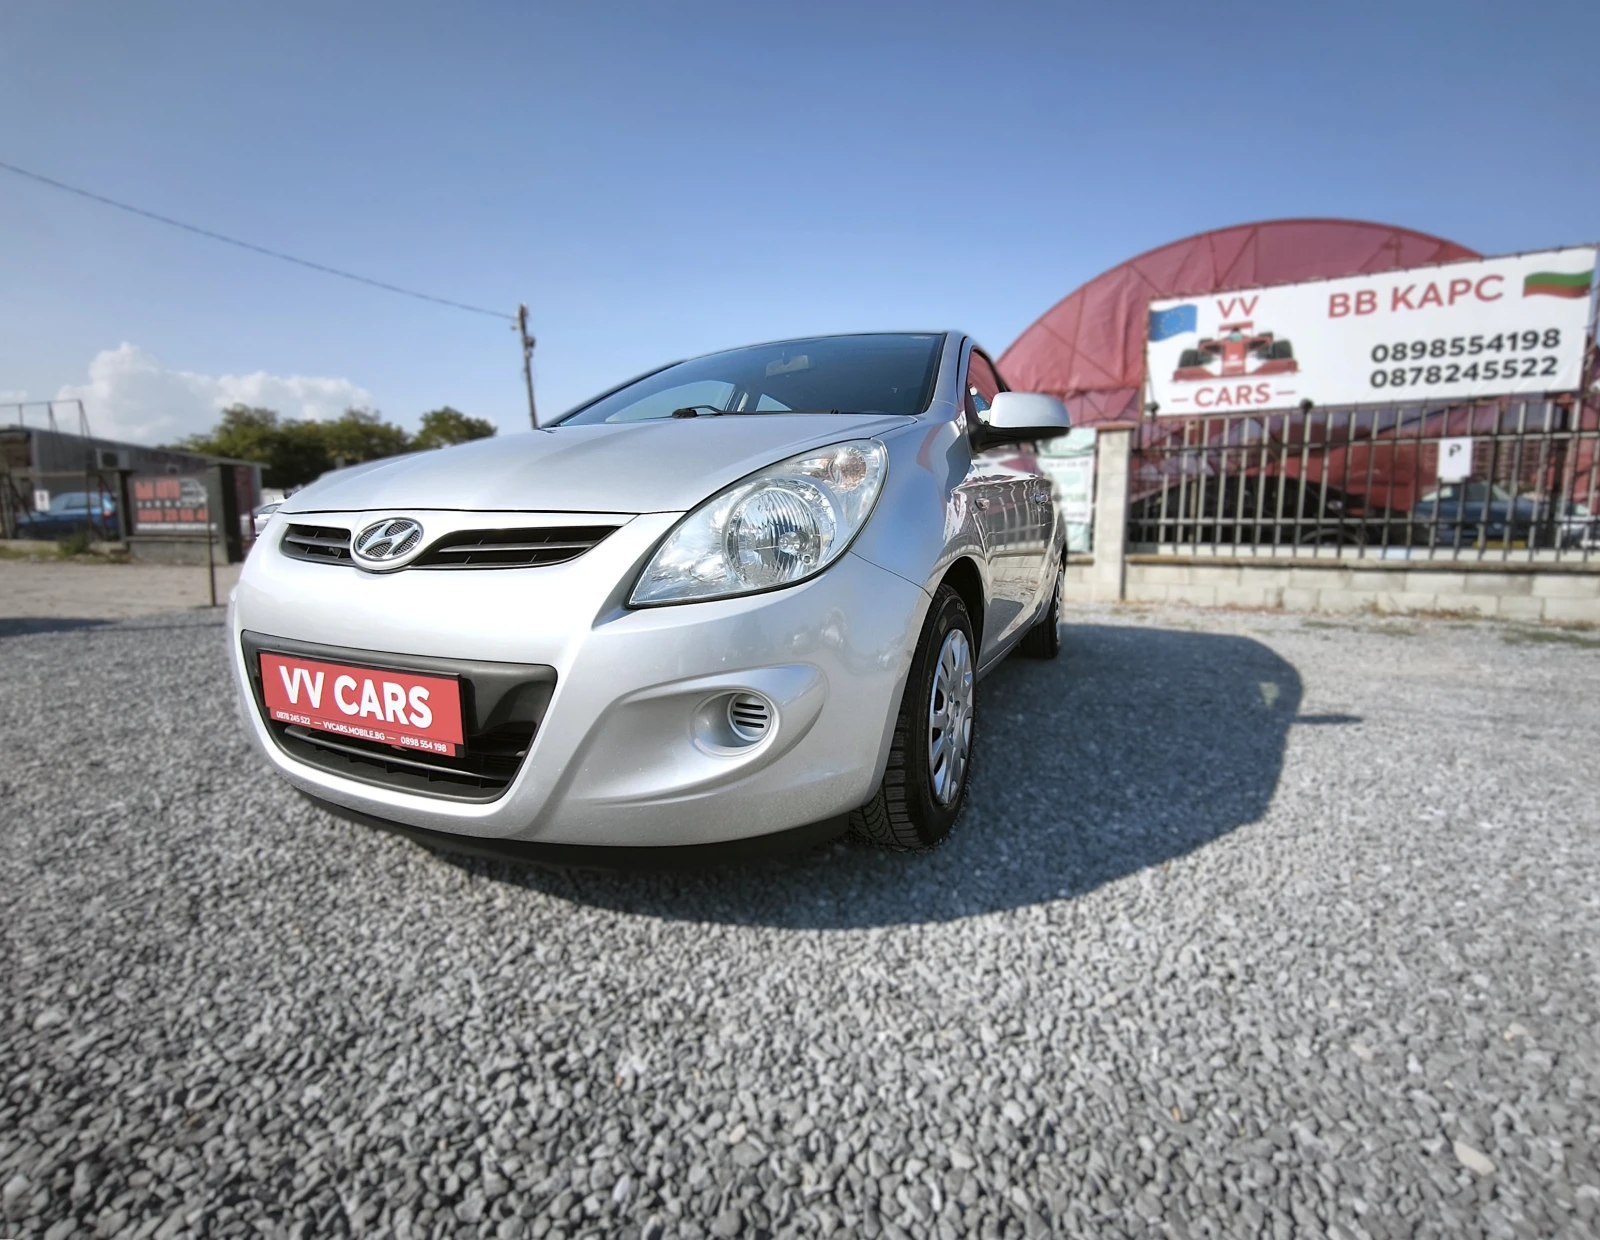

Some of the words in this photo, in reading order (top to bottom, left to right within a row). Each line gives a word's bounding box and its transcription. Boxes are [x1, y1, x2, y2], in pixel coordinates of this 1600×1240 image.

[1217, 295, 1259, 319] VV
[1391, 274, 1505, 312] КАРС
[1371, 328, 1561, 364] 0898554198
[1370, 355, 1558, 389] 0878245522
[1194, 383, 1271, 408] CARS
[278, 665, 325, 709] VV
[333, 674, 433, 729] CARS
[276, 710, 290, 721] 0878
[290, 713, 300, 723] 245
[300, 715, 311, 725] 522
[322, 720, 386, 741] VVCARS.MOBILE.BG
[400, 735, 420, 747] 0898
[420, 740, 433, 750] 554
[433, 742, 448, 753] 198
